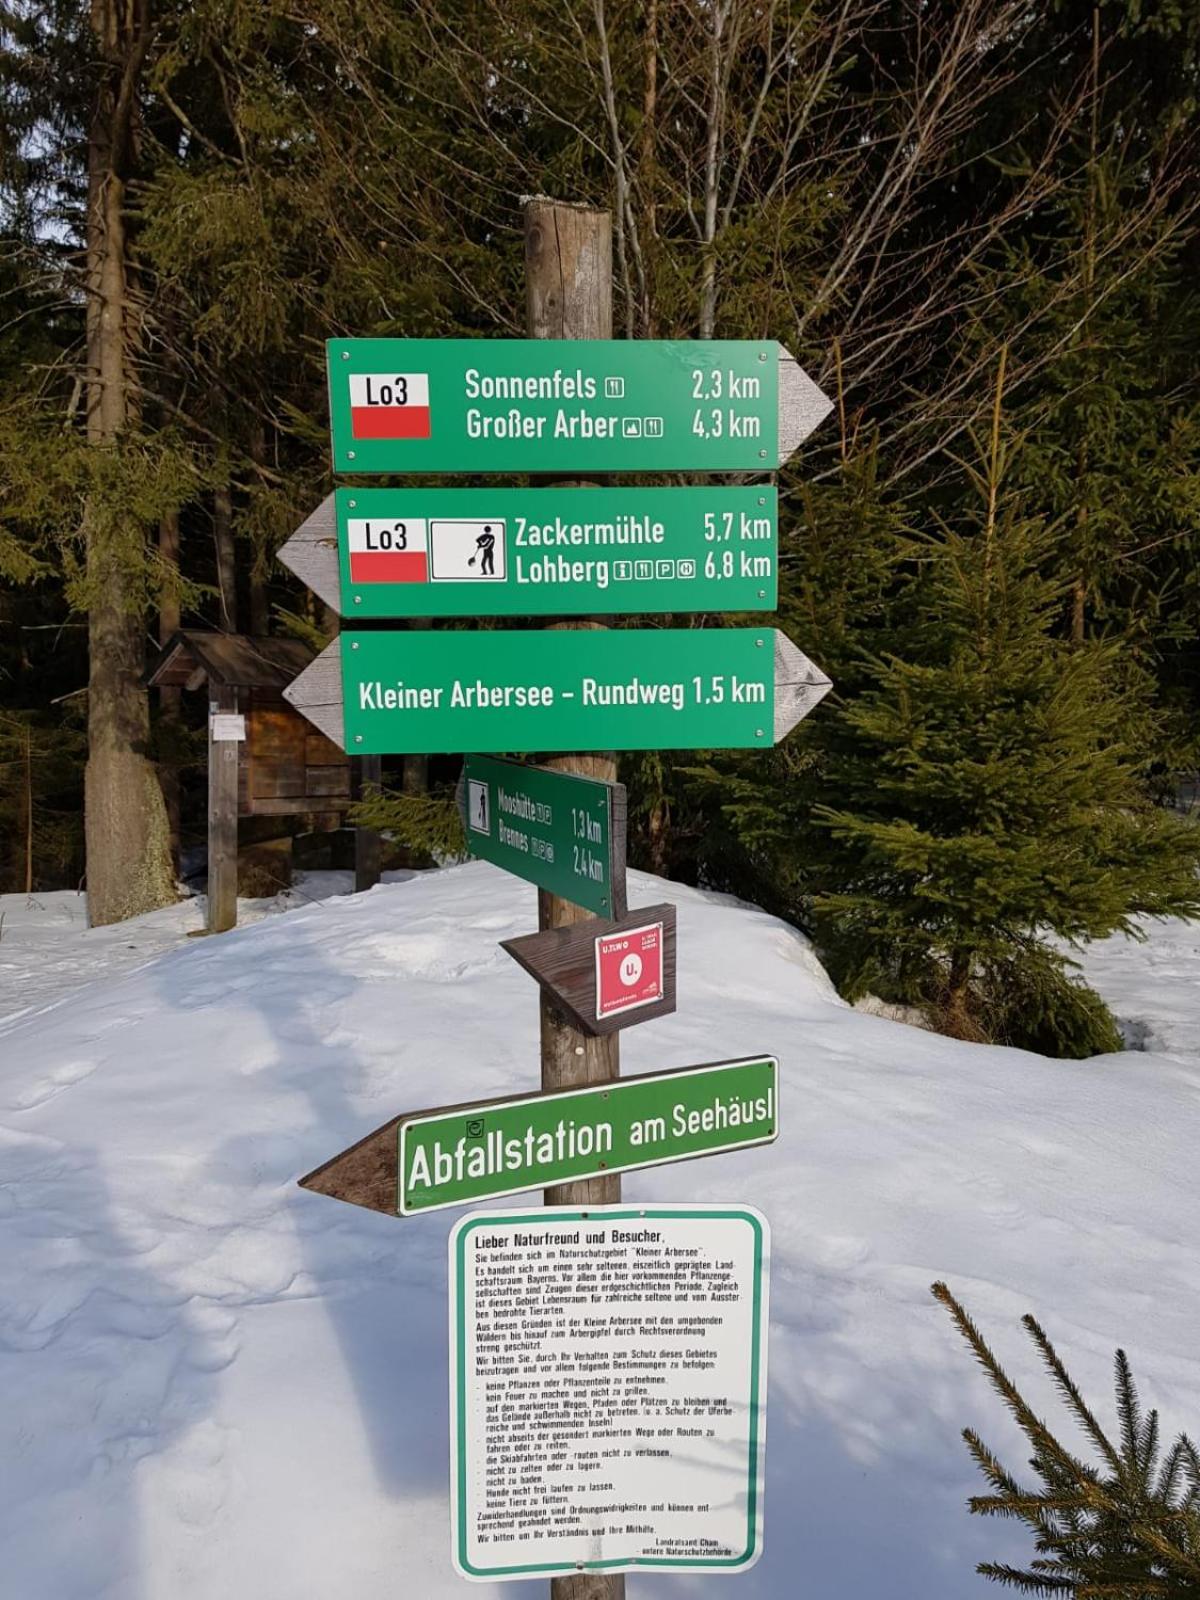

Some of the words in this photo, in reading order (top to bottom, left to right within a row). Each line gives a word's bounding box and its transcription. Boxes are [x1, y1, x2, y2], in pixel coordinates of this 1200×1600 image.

[365, 376, 408, 406] Lo3
[465, 370, 596, 399] Sonnenfels
[692, 370, 722, 399] 2,3
[729, 370, 760, 398] km
[467, 410, 545, 438] Großer
[554, 408, 616, 437] Arber
[692, 410, 722, 439] 4,3
[730, 410, 760, 437] km
[365, 522, 407, 550] Lo3
[516, 517, 664, 546] Zackermühle
[704, 513, 733, 542] 5,7
[741, 512, 770, 539] km
[517, 556, 609, 588] Lohberg
[704, 551, 733, 580] 6,8
[741, 550, 770, 577] km
[359, 682, 443, 709] Kleiner
[451, 681, 553, 708] Arbersee
[583, 679, 684, 710] Rundweg
[692, 677, 724, 704] 1,5
[732, 676, 765, 702] km
[572, 808, 585, 838] 1,3
[587, 812, 601, 844] km
[499, 818, 528, 853] Brennes
[574, 845, 586, 876] 2,4
[589, 850, 603, 882] km
[408, 1120, 612, 1191] Abfallstation
[630, 1118, 664, 1146] am
[673, 1088, 773, 1137] Seehäusl
[475, 1234, 509, 1249] Lieber
[514, 1231, 579, 1247] Naturfreund
[585, 1231, 605, 1244] und
